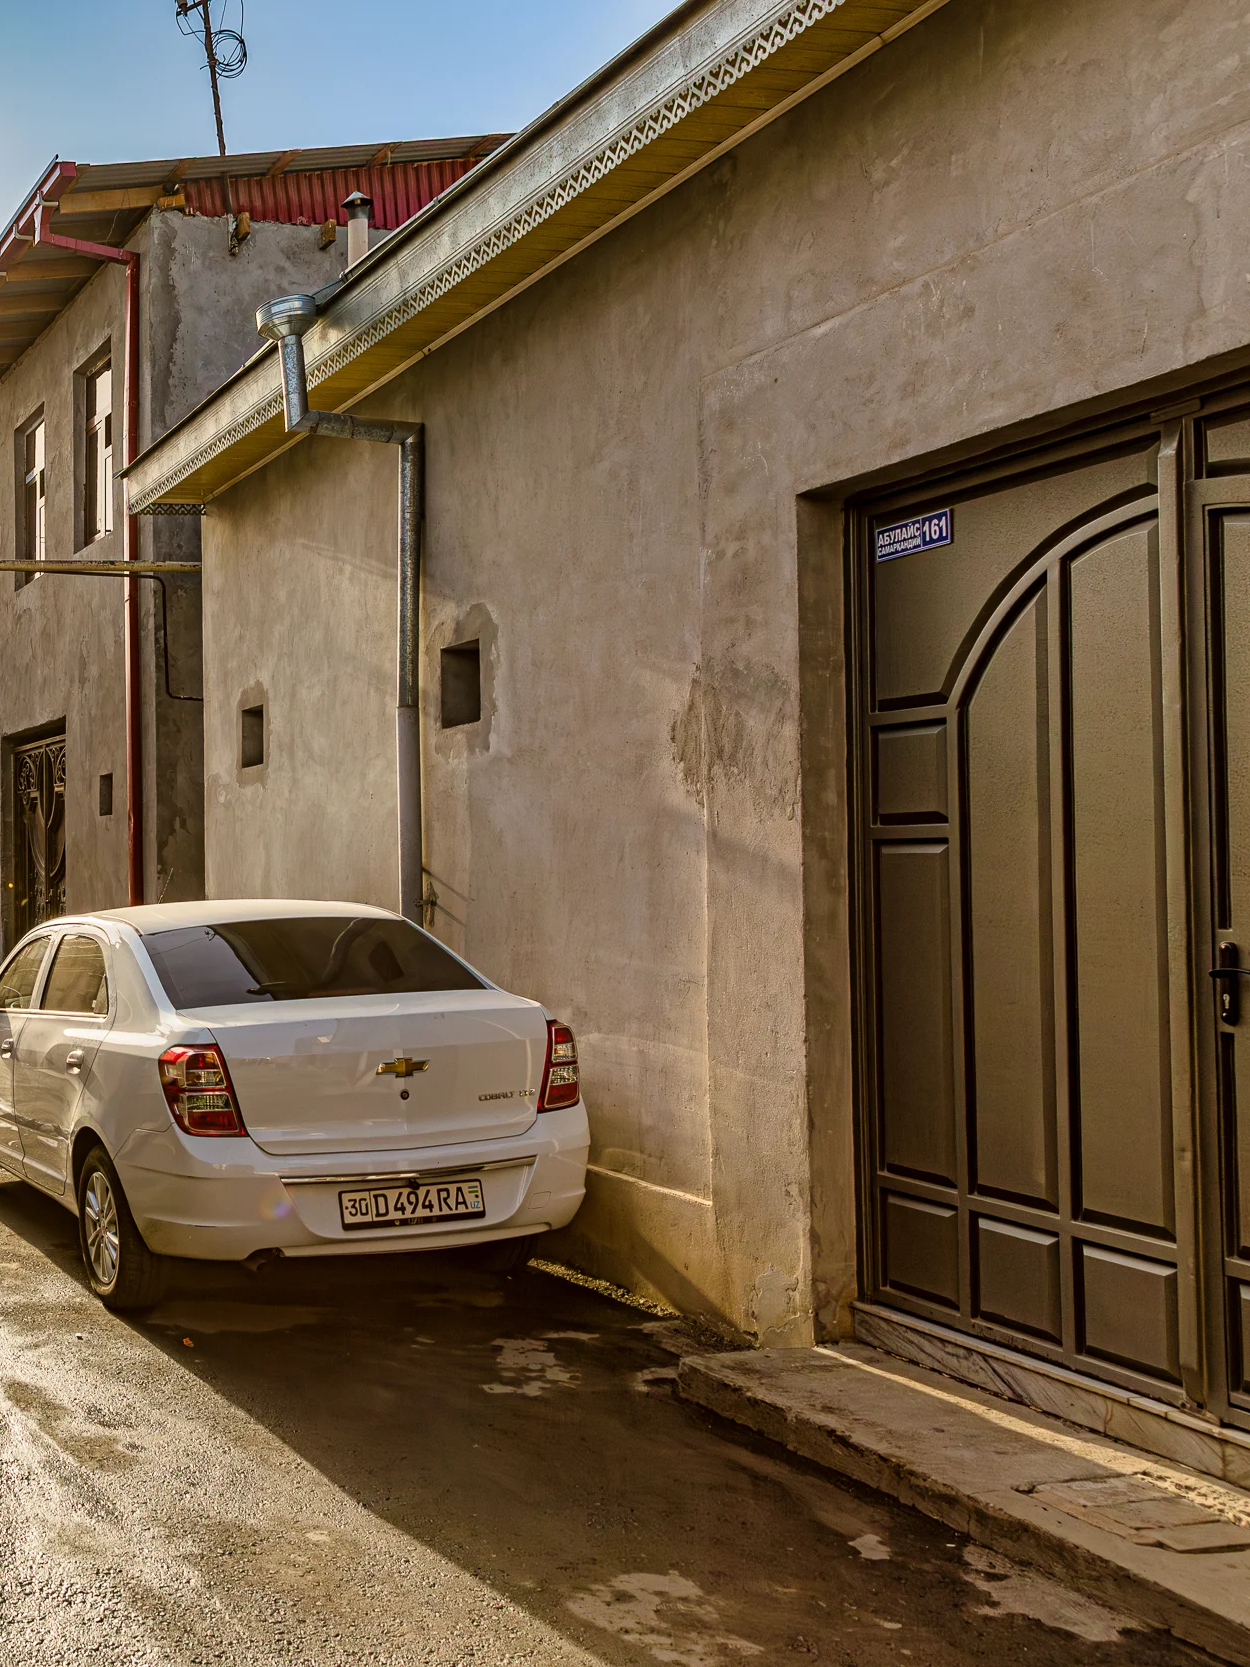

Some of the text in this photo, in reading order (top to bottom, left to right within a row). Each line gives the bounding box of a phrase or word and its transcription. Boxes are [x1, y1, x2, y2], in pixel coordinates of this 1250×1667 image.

[878, 523, 921, 547] АБУЛАЙС
[923, 516, 946, 541] 161
[347, 1198, 369, 1217] 30
[470, 1200, 481, 1209] UZ
